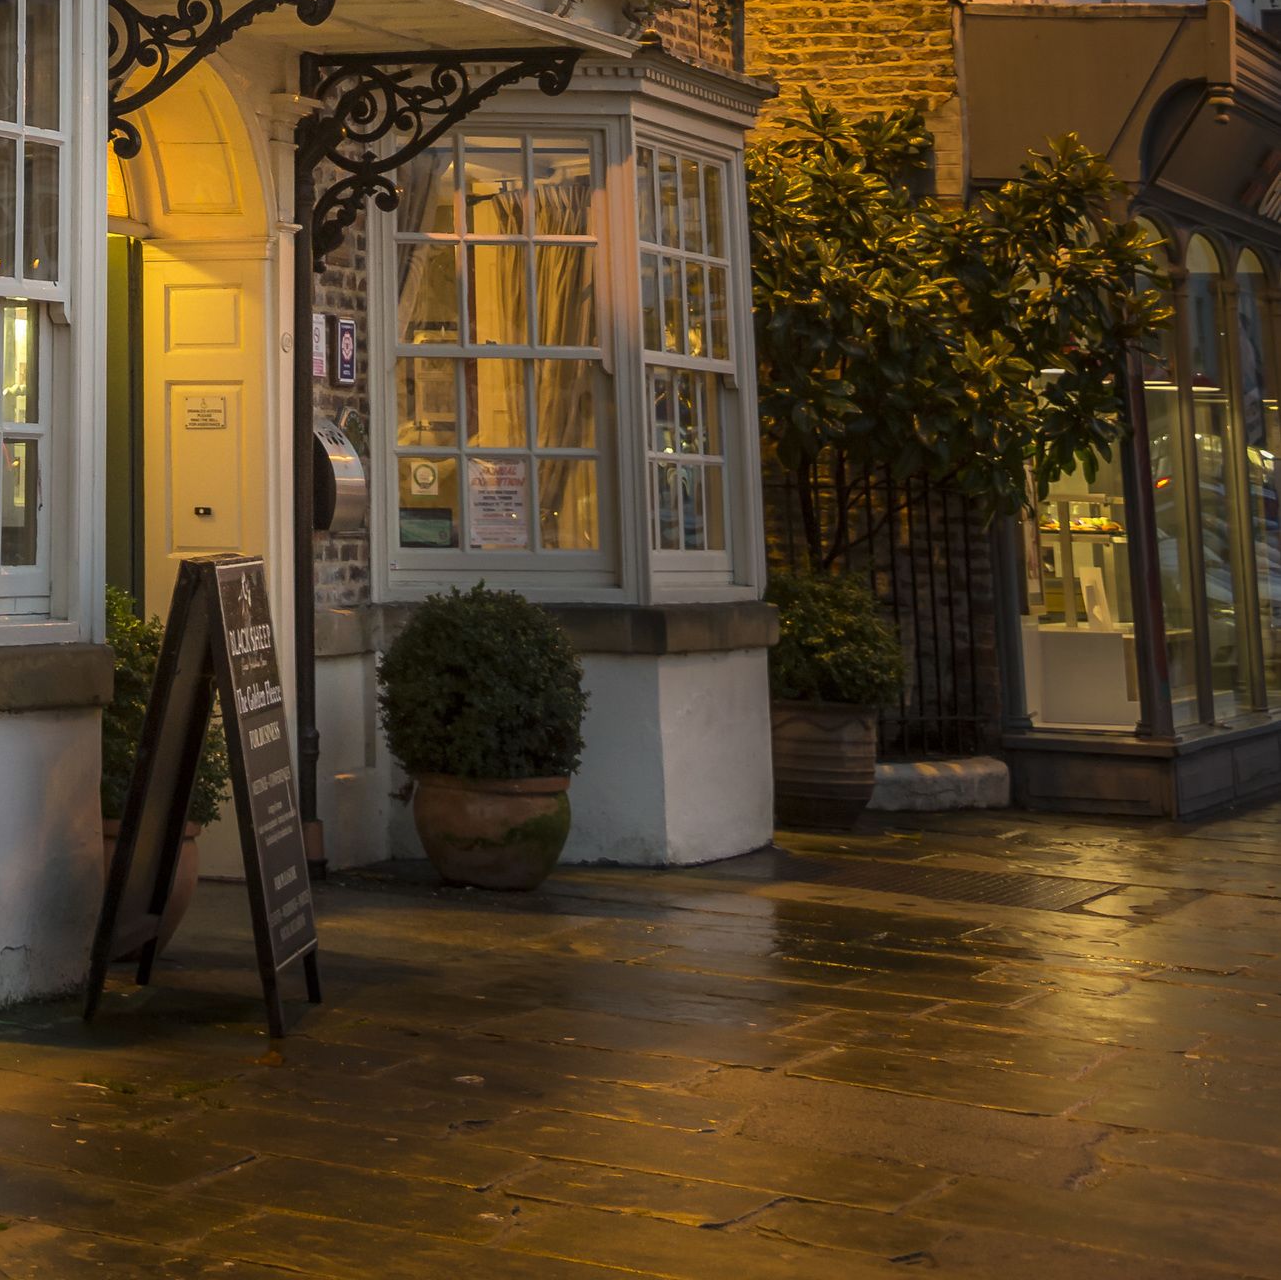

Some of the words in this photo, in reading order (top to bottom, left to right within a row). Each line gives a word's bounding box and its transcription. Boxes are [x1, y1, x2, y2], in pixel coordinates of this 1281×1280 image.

[229, 627, 252, 656] BLACK
[249, 624, 271, 651] SHEEP
[236, 688, 248, 714] The
[246, 682, 267, 711] Golden
